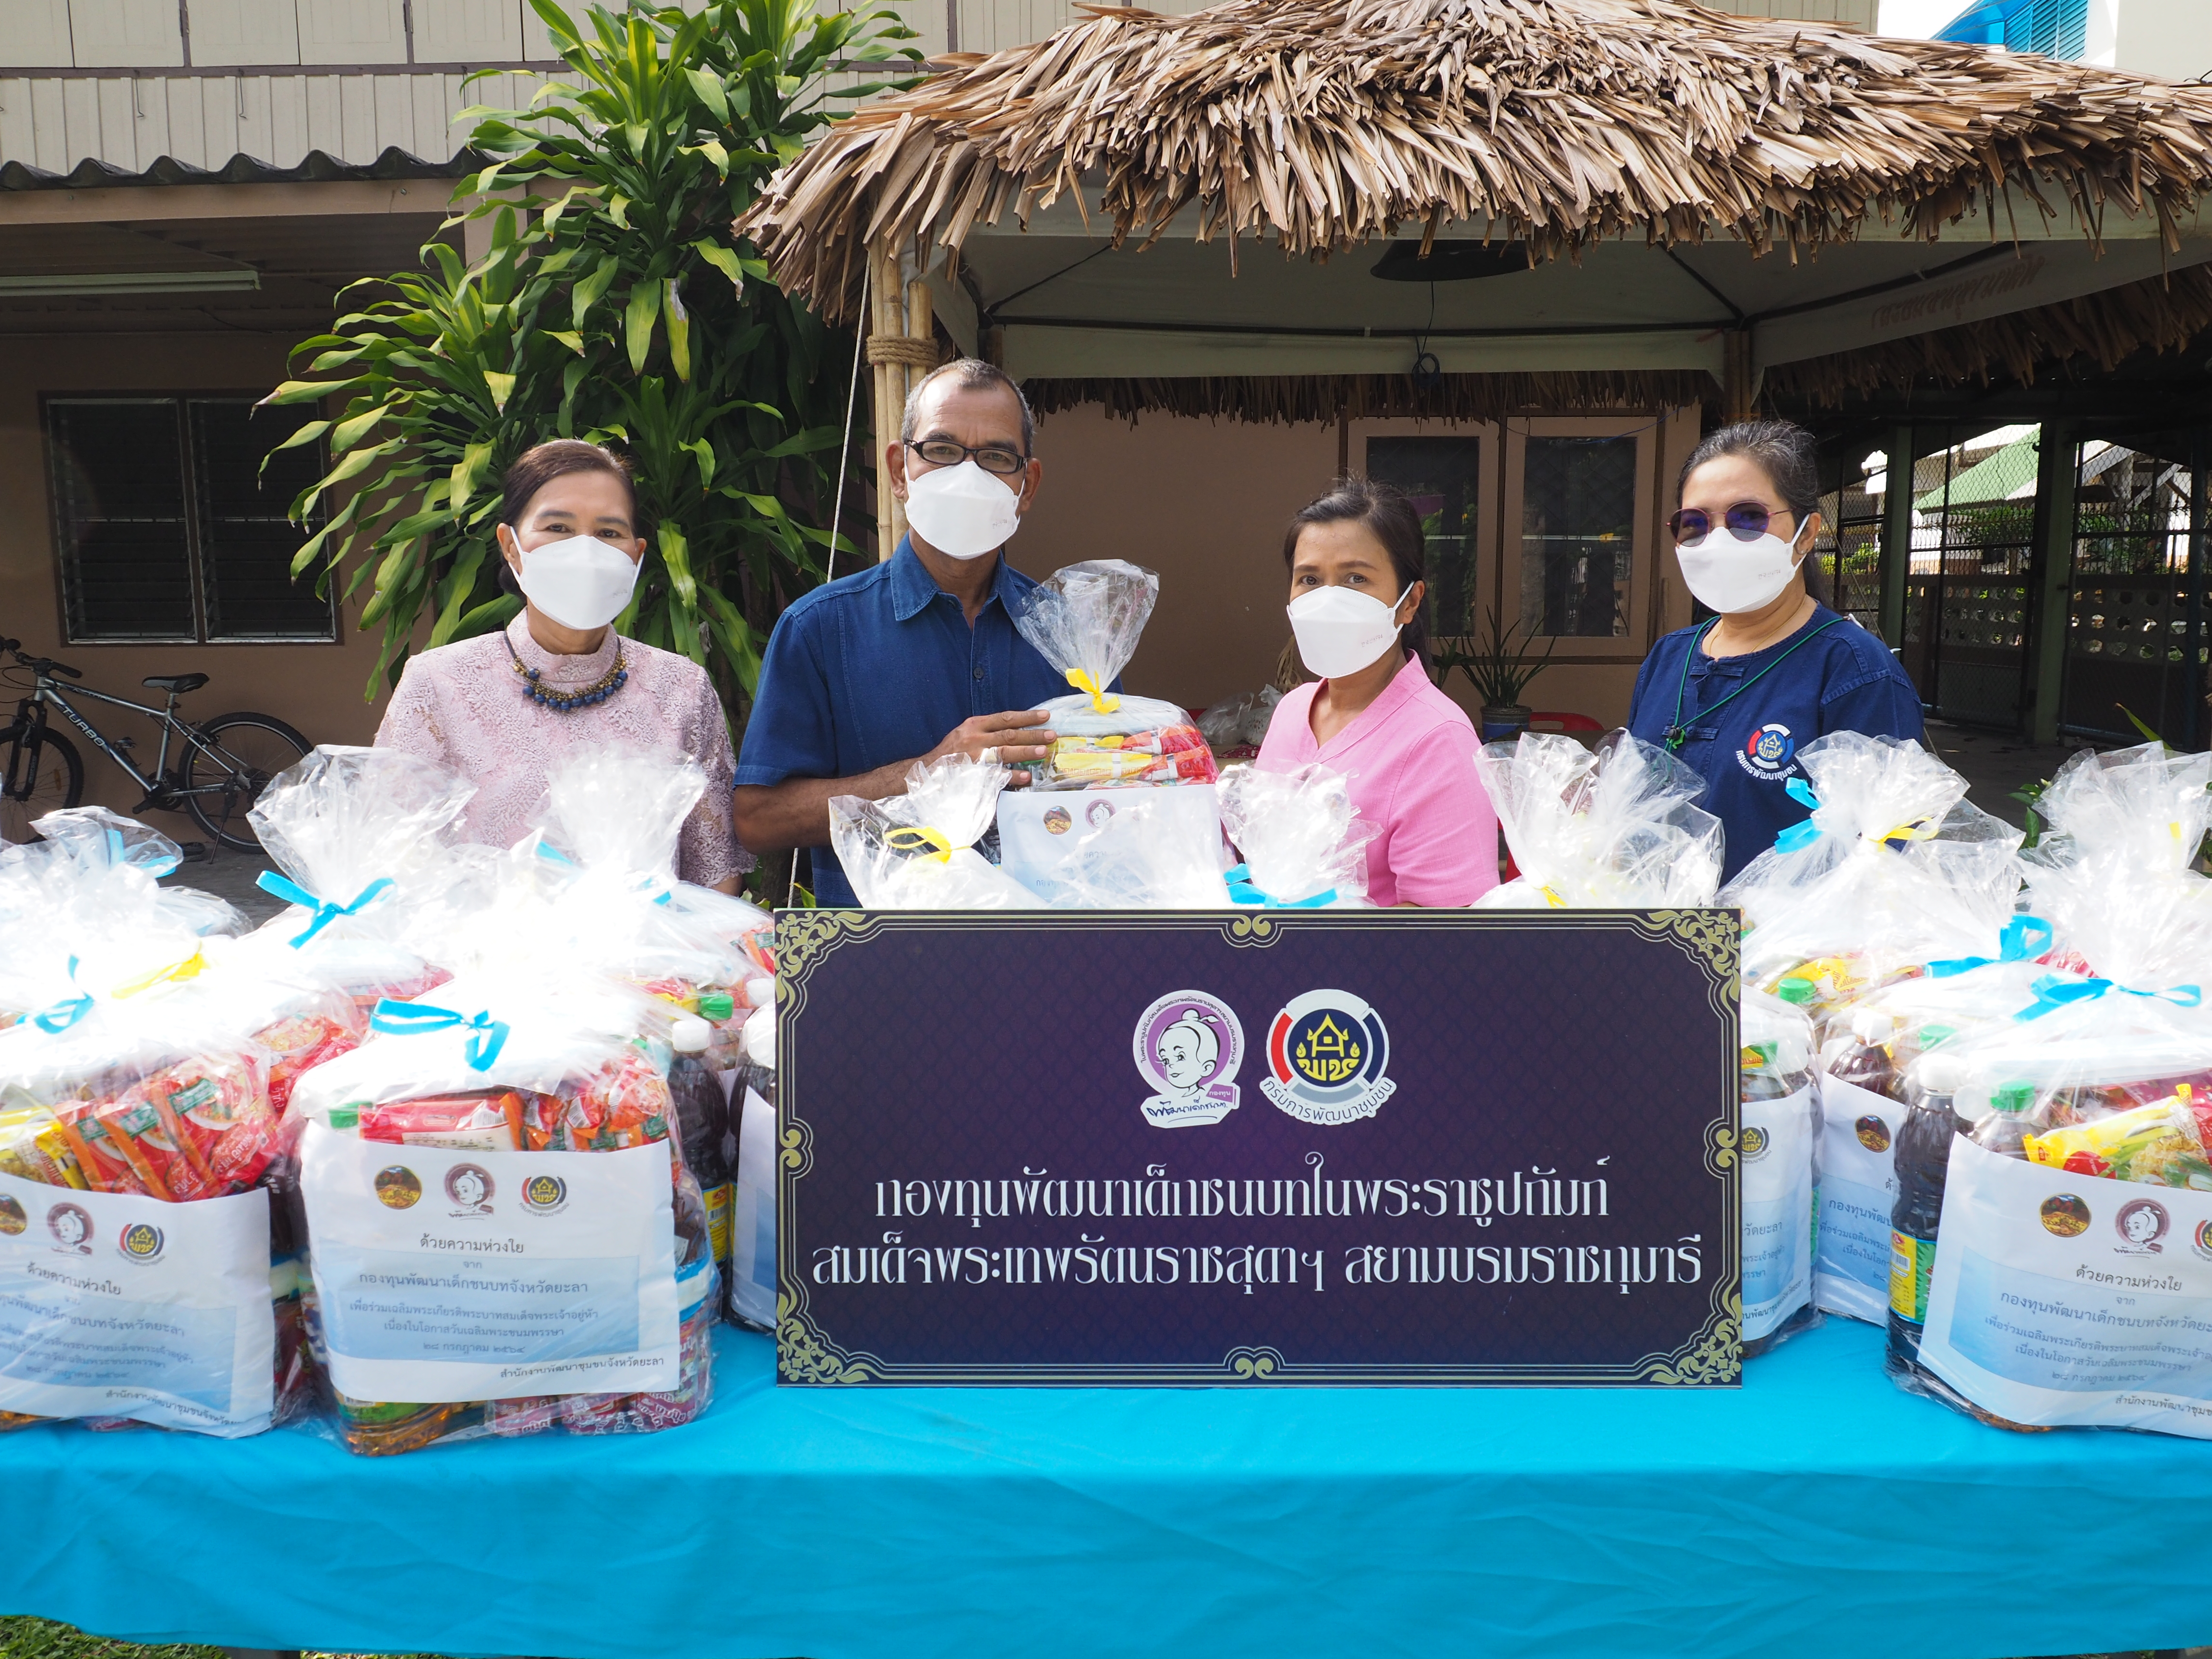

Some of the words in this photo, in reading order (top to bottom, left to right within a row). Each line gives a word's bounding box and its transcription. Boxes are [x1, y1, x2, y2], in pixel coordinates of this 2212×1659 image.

[62, 705, 105, 747] TURBO
[1736, 750, 1798, 781] กรมการพัฒนาชุมชน
[1209, 1090, 1231, 1098] กองทุน
[1263, 1080, 1393, 1122] กรมการพัฒนาชุมชน
[875, 1152, 1609, 1227] กองทุนพัฒนาเด็กชนบทในพระราชูปถัมภ์
[1743, 1222, 1782, 1236] วัดยะลา
[420, 1233, 524, 1253] ด้วยความห่วงใย
[463, 1260, 482, 1269] จาก
[813, 1230, 1325, 1294] สมเด็จพระเทพรัตนราชสุดาฯ
[1345, 1234, 1702, 1294] สยามบรมราชกุมารี
[27, 1262, 121, 1295] ด้วยความห่วงใย
[359, 1273, 588, 1294] กองทุนพัฒนาเด็กชนบทจังหวัดยะลา
[2076, 1264, 2182, 1291] ด้วยความห่วงใย
[350, 1297, 598, 1322] เพื่อร่วมเฉลิมพระเกียรติพระบาทสมเด็จพระเจ้าอยู่หัว
[2116, 1296, 2136, 1306] จาก
[384, 1318, 564, 1337] เนื่องในโอกาสวันเฉลิมพระชนมพรรษา
[1985, 1315, 2212, 1362] เพื่อร่วมเฉลิมพระเกียรติพระบาทสมเด็จพระเจ้าอ
[443, 1343, 489, 1354] กรกฎาคม
[493, 1345, 525, 1353] ๒๕๖๔
[500, 1356, 664, 1378] สำนักงานพัฒนาชุมชนจังหวัดยะลา
[2052, 1370, 2069, 1380] ๒๘
